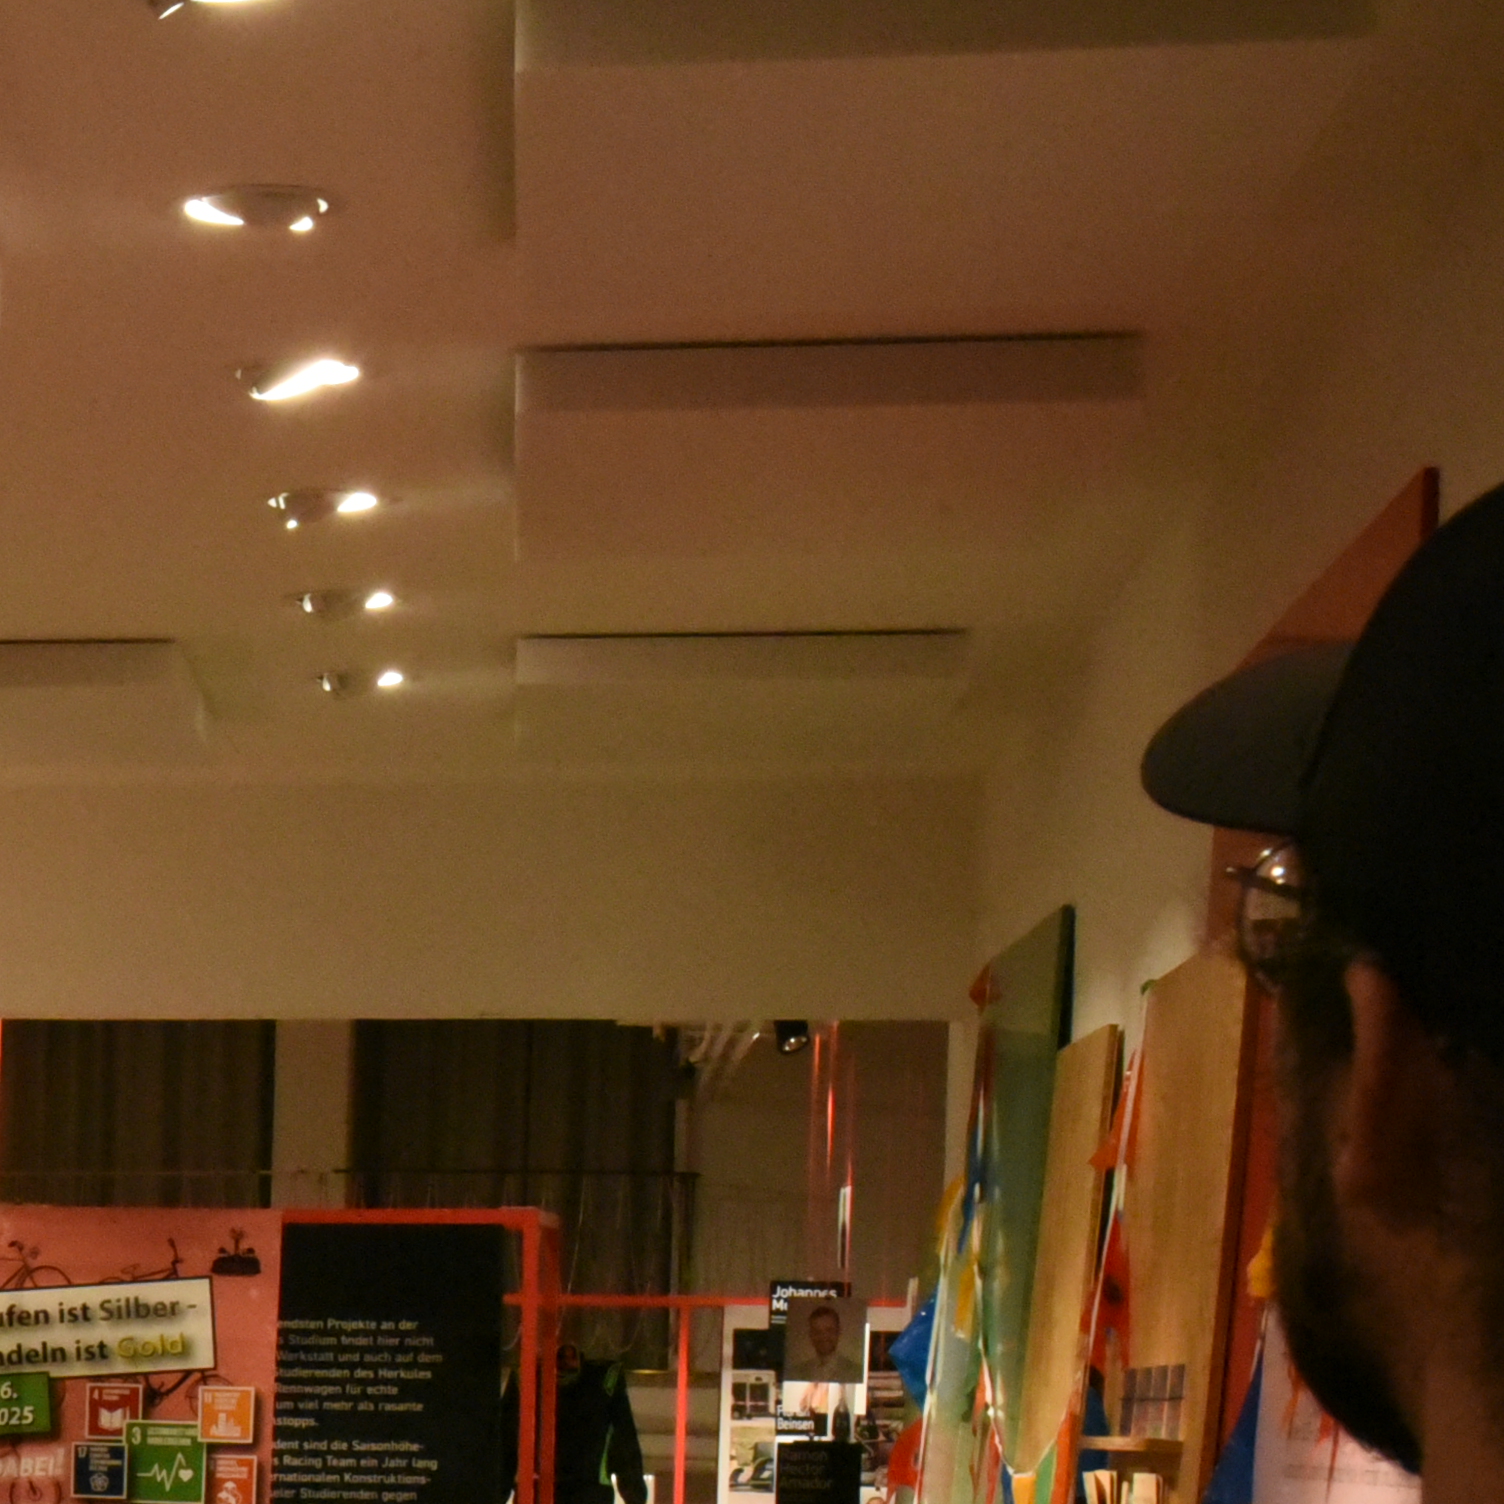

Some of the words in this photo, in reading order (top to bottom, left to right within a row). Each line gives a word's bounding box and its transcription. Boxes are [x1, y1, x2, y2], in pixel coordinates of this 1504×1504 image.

[58, 1302, 91, 1323] ist
[99, 1297, 180, 1322] Silber
[327, 1318, 377, 1331] Projekte
[380, 1320, 395, 1330] an
[398, 1319, 419, 1330] der
[288, 1334, 337, 1345] Studium
[75, 1339, 108, 1362] ist
[117, 1332, 186, 1358] Gold
[337, 1351, 359, 1362] und
[353, 1368, 375, 1378] des
[378, 1368, 432, 1379] Herkules
[0, 1380, 18, 1399] 6.
[345, 1384, 362, 1394] für
[366, 1385, 399, 1395] echte
[357, 1400, 375, 1411] als
[378, 1402, 424, 1412] rasante
[302, 1440, 328, 1451] sind
[330, 1440, 348, 1451] die
[283, 1455, 323, 1469] Racing
[326, 1456, 357, 1467] Team
[360, 1457, 378, 1467] ein
[381, 1457, 408, 1468] Jahr
[411, 1457, 439, 1470] lang
[300, 1487, 379, 1500] Studierenden
[382, 1490, 417, 1502] gegen
